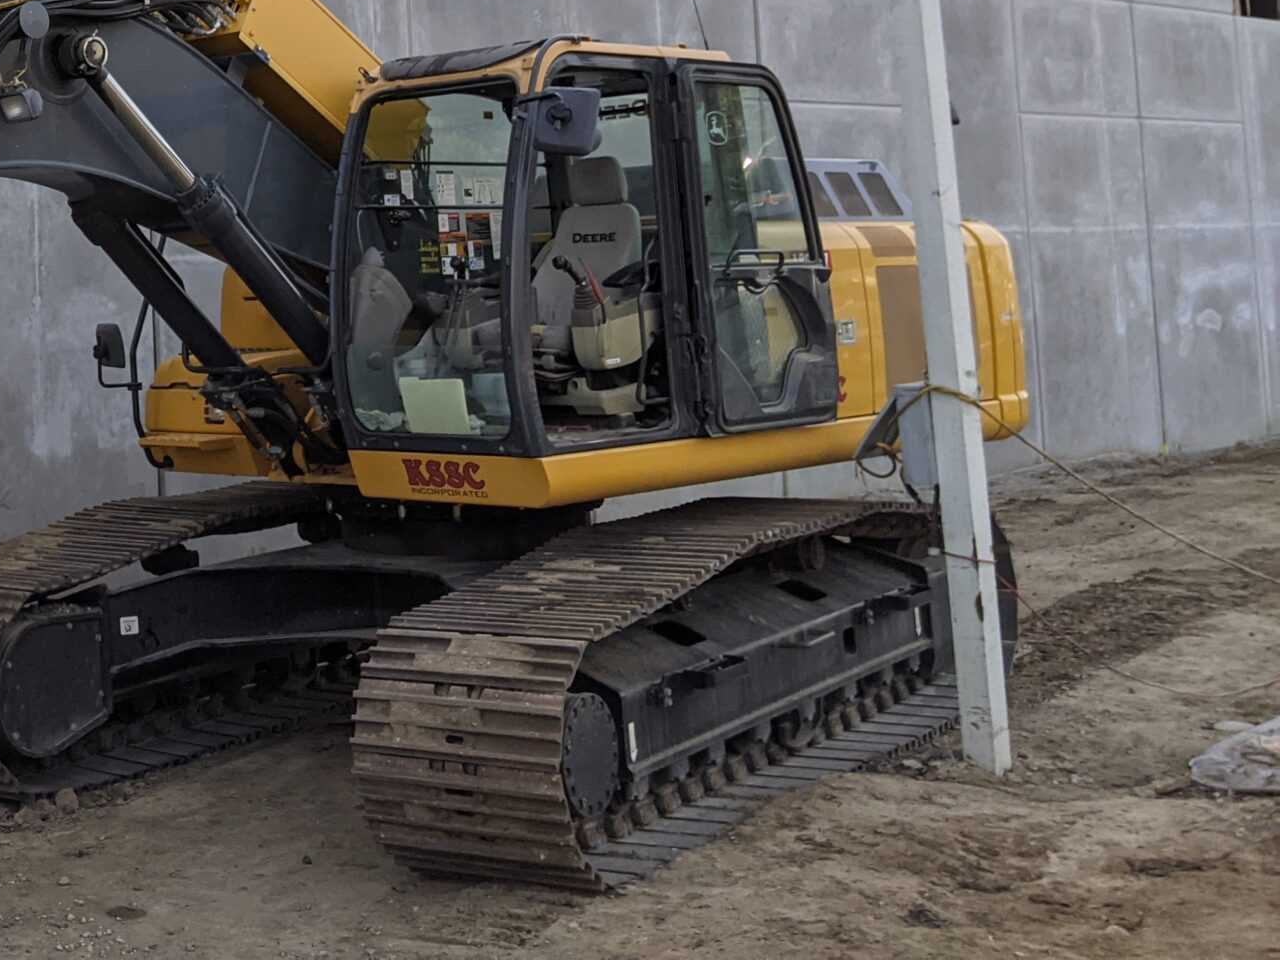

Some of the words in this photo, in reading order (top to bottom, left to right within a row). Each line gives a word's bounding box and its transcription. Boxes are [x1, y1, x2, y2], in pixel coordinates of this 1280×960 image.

[572, 232, 617, 244] DEERE
[401, 458, 486, 490] KSSC
[410, 487, 489, 498] INCORPORATED
